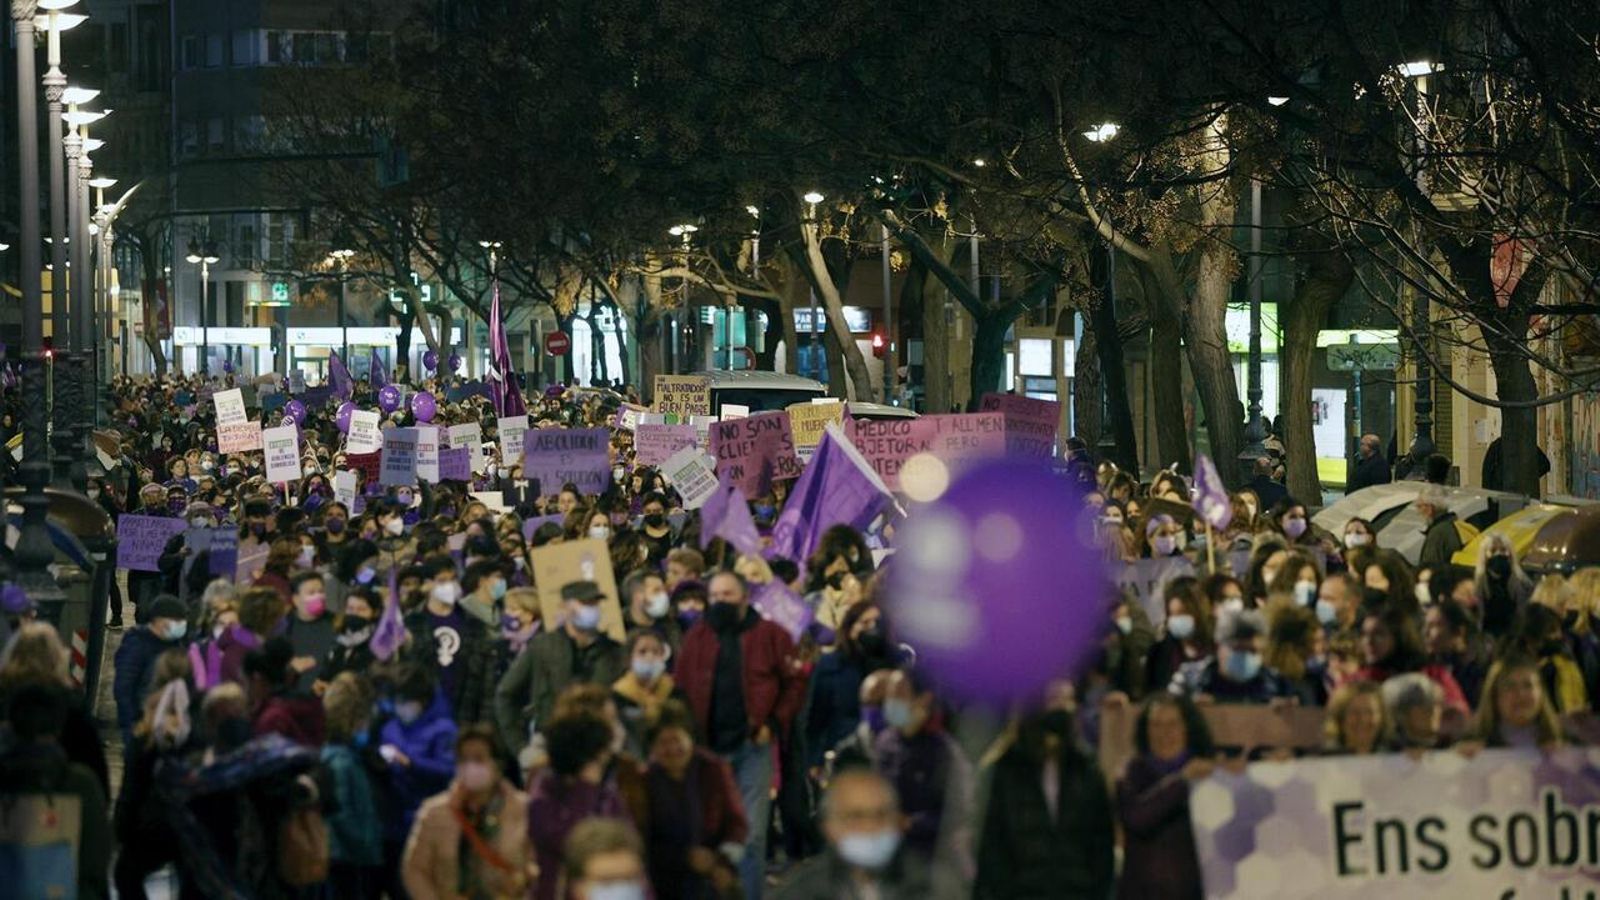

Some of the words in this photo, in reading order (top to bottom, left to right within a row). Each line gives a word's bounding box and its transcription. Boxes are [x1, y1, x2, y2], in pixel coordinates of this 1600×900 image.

[663, 393, 673, 402] NO
[680, 393, 691, 402] ES
[659, 402, 682, 414] BUEN
[685, 402, 709, 416] PADRE
[719, 422, 740, 442] NO
[855, 420, 911, 437] MEDICO
[951, 416, 973, 434] ALL
[975, 414, 1003, 433] MEN
[855, 437, 918, 456] BJETOR
[1333, 800, 1449, 876] Ens
